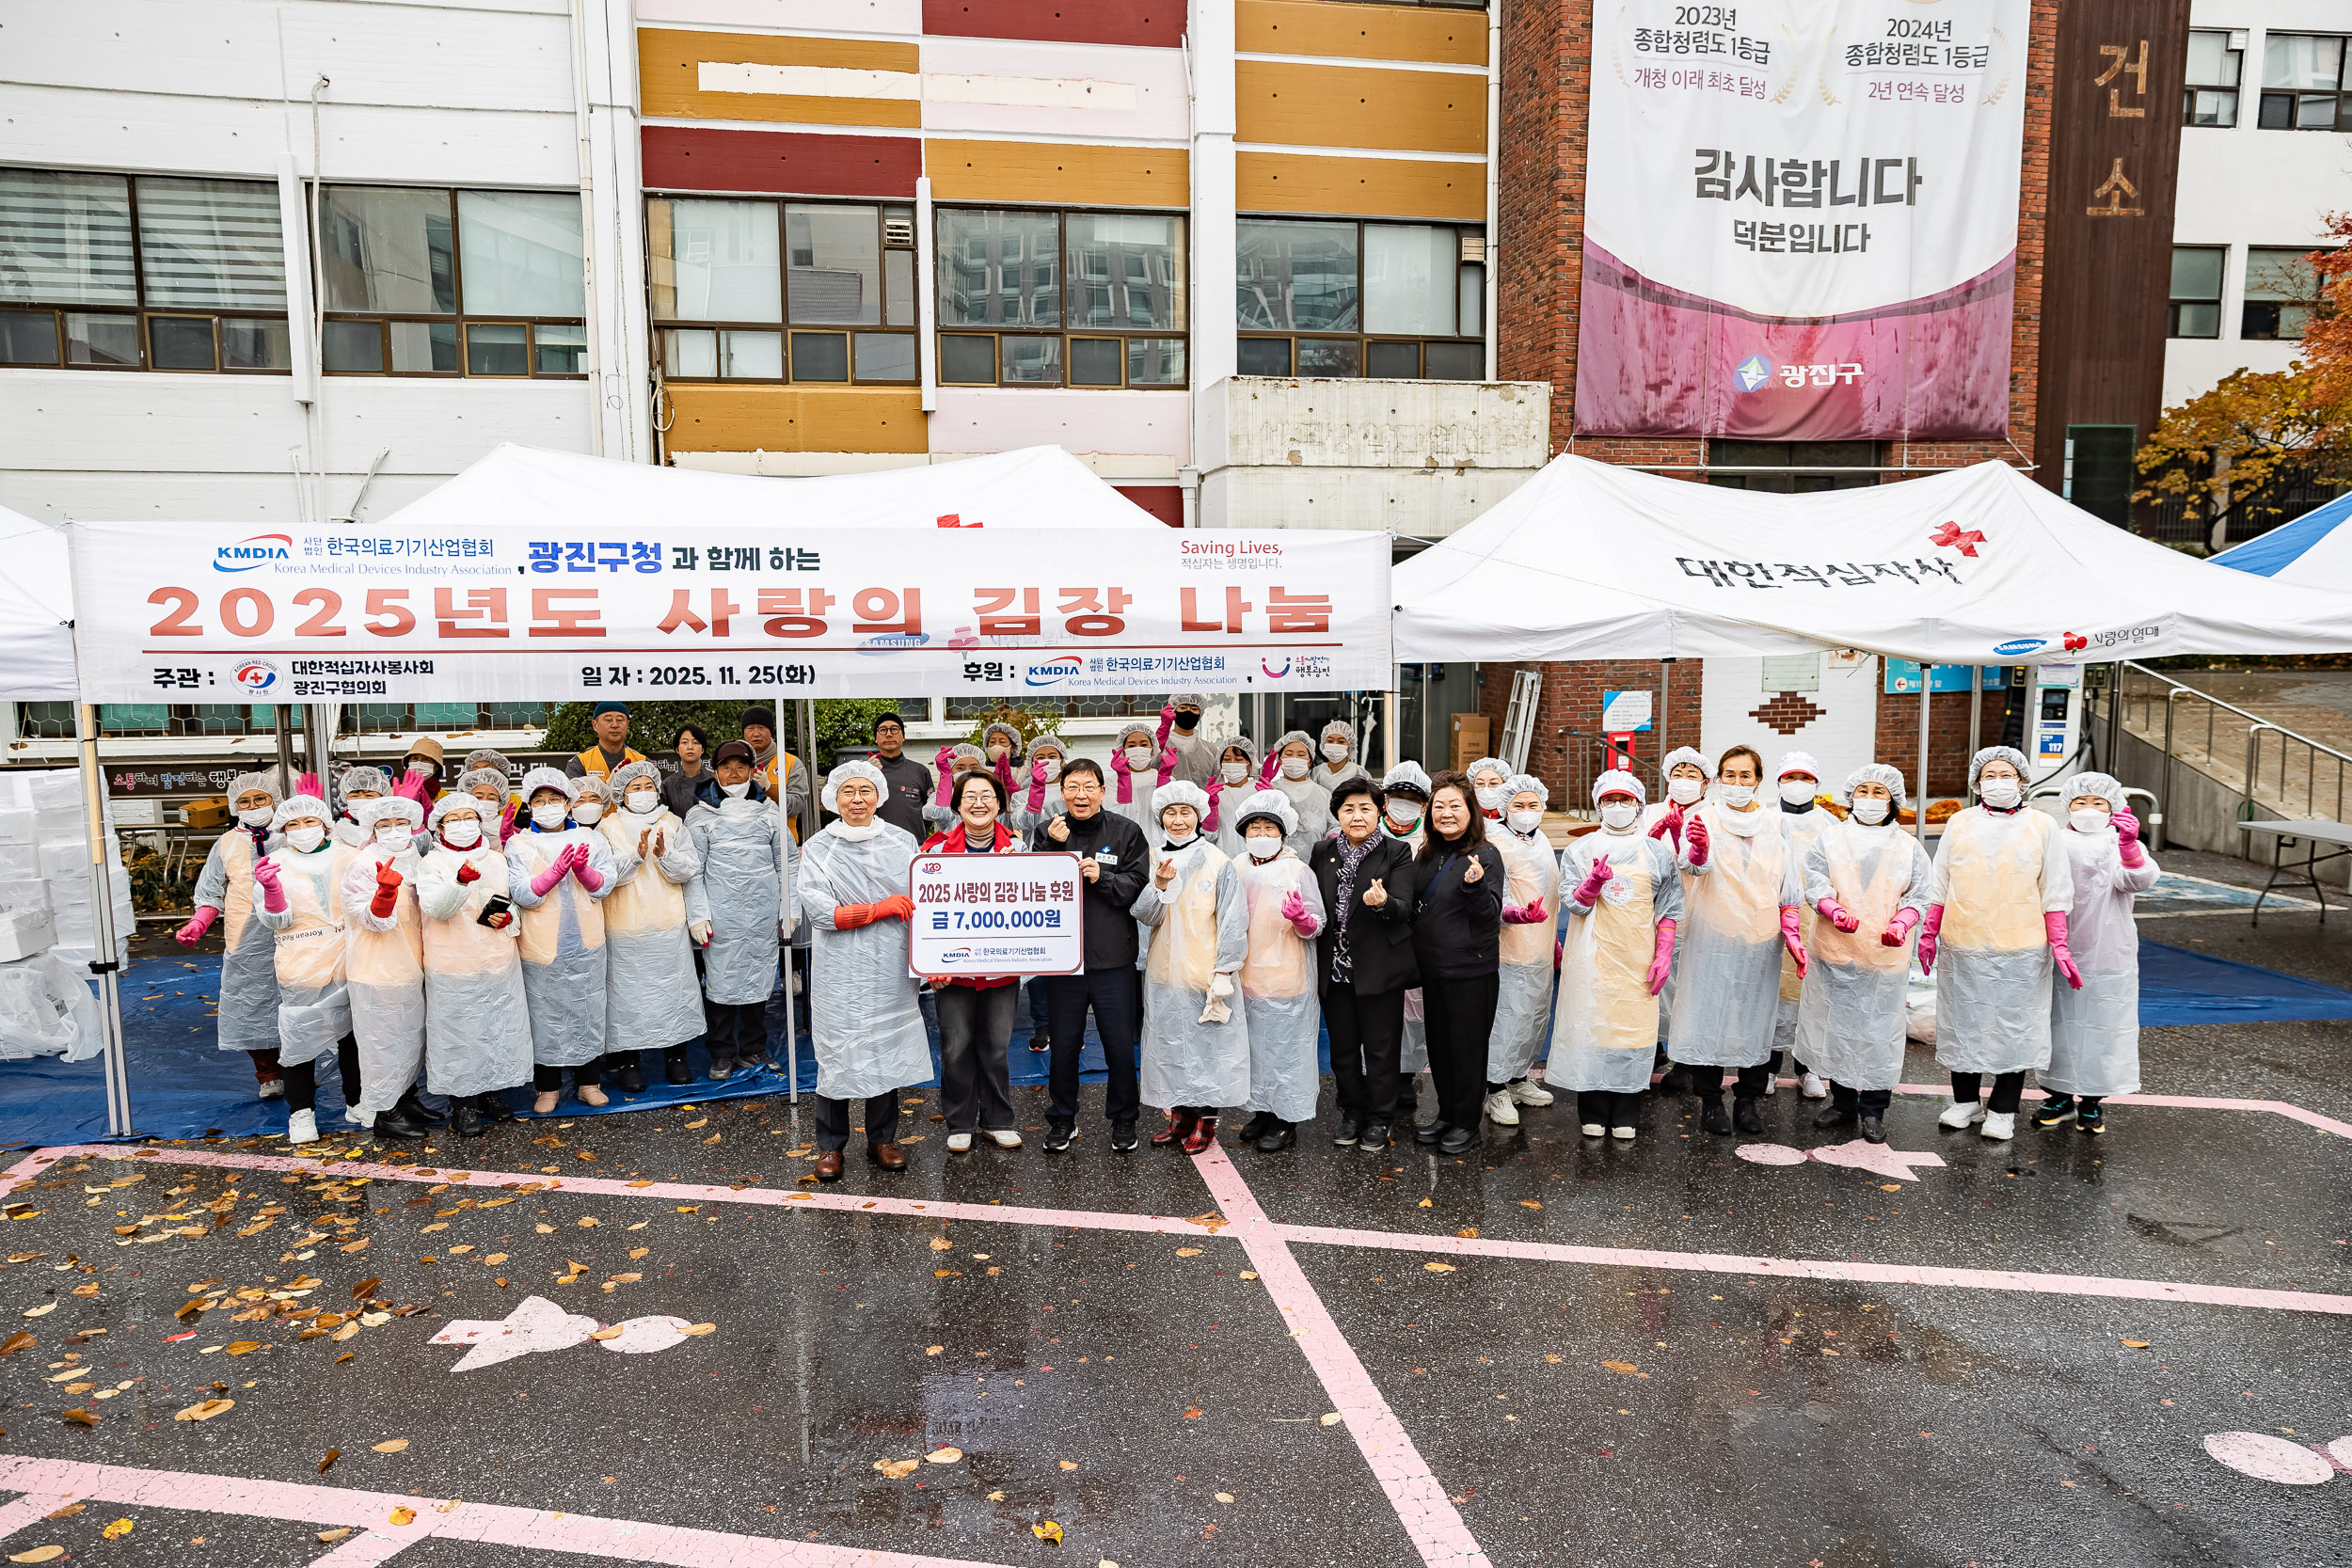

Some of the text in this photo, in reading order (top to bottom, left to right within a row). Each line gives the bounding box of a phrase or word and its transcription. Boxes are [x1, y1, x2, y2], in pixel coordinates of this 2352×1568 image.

[1675, 6, 1736, 32] 2023년
[1886, 18, 1952, 43] 2024년
[1633, 27, 1771, 65] 종합청렴도 1등급
[1845, 41, 1989, 69] 종합청렴도 1등급
[1634, 67, 1766, 101] 개청 이래 최초 달성
[1868, 80, 1964, 103] 2년 연속 달성
[1694, 149, 1923, 209] 감사합니다
[1734, 219, 1870, 254] 덕분입니다
[1778, 362, 1865, 388] 광진구
[303, 536, 322, 546] 사단
[304, 546, 323, 556] 법인
[1181, 540, 1283, 558] Saving Lives,
[217, 546, 290, 560] KMDIA
[326, 536, 494, 558] 한국의료기기산업협회
[528, 541, 663, 575] 광진구청
[672, 546, 699, 571] 과
[707, 546, 761, 572] 함께
[769, 546, 820, 572] 하는
[274, 562, 513, 578] Korea Medical Devices Industry Association
[1181, 557, 1282, 570] 적십자는 생명입니다.
[1676, 556, 1963, 589] 대한적십자사
[147, 585, 1334, 640] 2025년도 사랑의 김장 나눔
[2095, 626, 2159, 646] 사랑의 열매
[1997, 641, 2042, 652] SAMSUNG
[292, 659, 434, 675] 대한적십자사봉사회
[963, 662, 1004, 682] 후원
[1029, 666, 1080, 675] KMDIA
[1106, 656, 1225, 672] 한국의료기기산업협회
[1295, 665, 1330, 677] 행복광진
[152, 668, 201, 689] 주관
[649, 667, 712, 687] 2025.
[720, 667, 742, 686] 11.
[749, 665, 816, 686] 25(화)
[1069, 675, 1237, 688] Korea Medical Devices Industry Association
[294, 680, 387, 695] 광진구협의회
[114, 769, 247, 790] 소통하며 발전하는 행복
[919, 880, 1073, 903] 2025 사랑의 김장 나눔 후원
[932, 910, 1061, 930] 금 7,000,000원
[983, 947, 1046, 956] 한국의료기기산업협회
